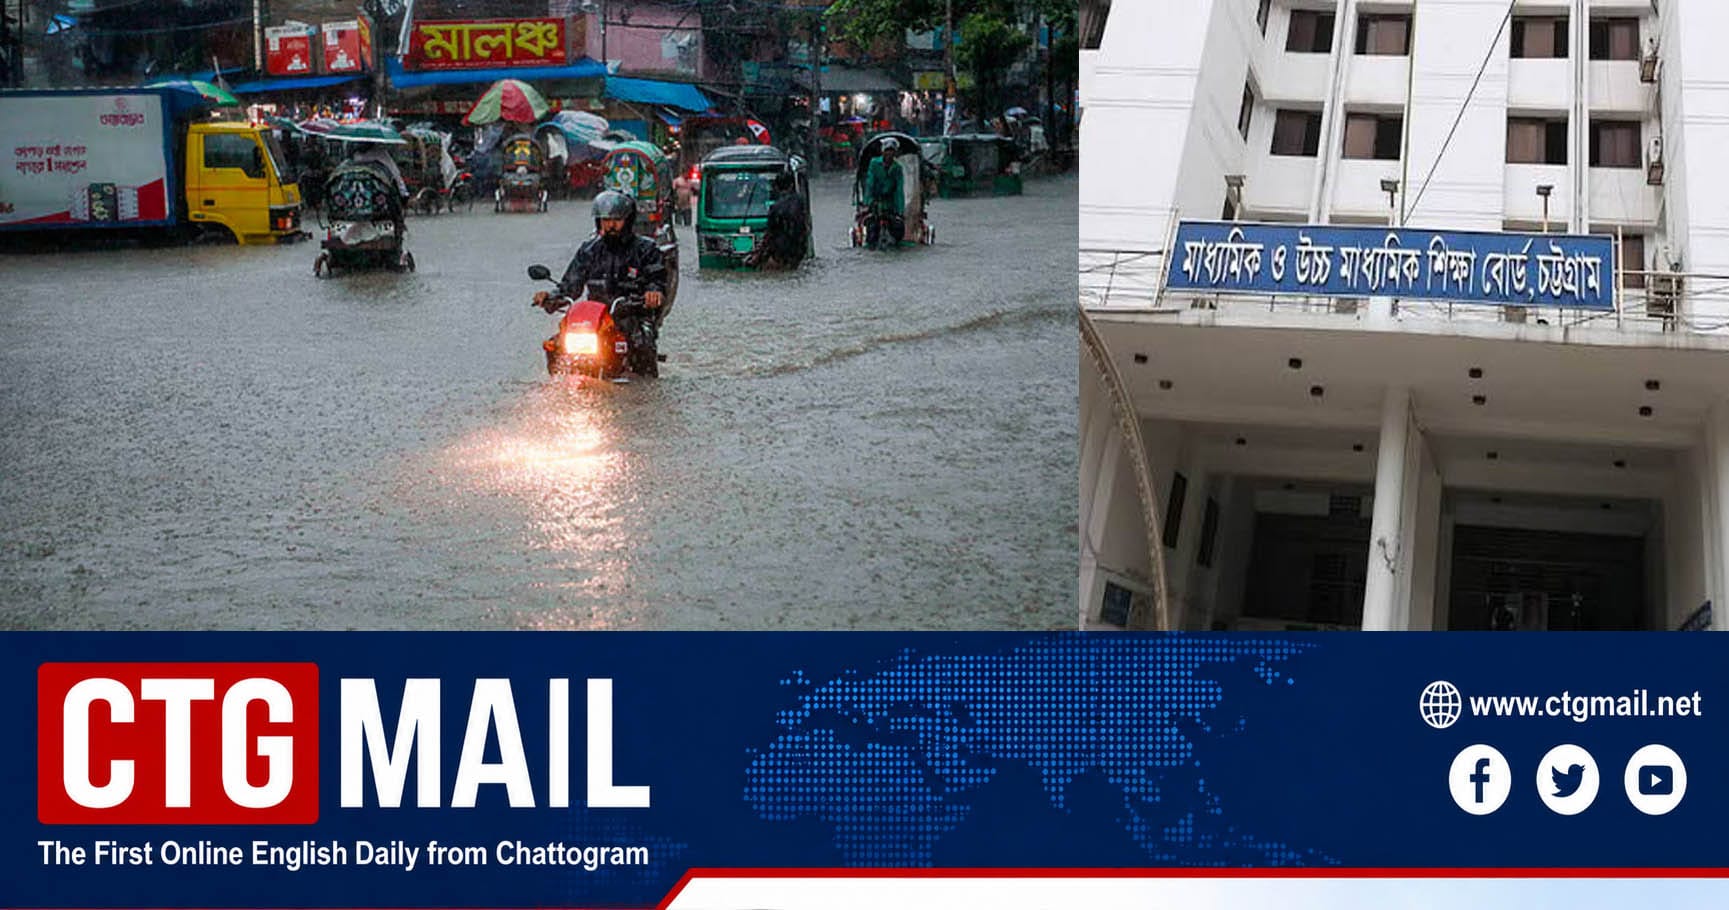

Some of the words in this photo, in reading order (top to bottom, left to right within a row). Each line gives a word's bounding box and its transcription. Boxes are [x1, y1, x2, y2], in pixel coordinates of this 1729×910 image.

[419, 22, 559, 60] মালঞ্চ
[1183, 227, 1264, 284] মাধ্যমিক
[1271, 244, 1287, 282] ও
[1296, 230, 1333, 284] উচ্চ
[1340, 232, 1422, 291] মাধ্যমিক
[1427, 235, 1477, 294] শিক্ষা
